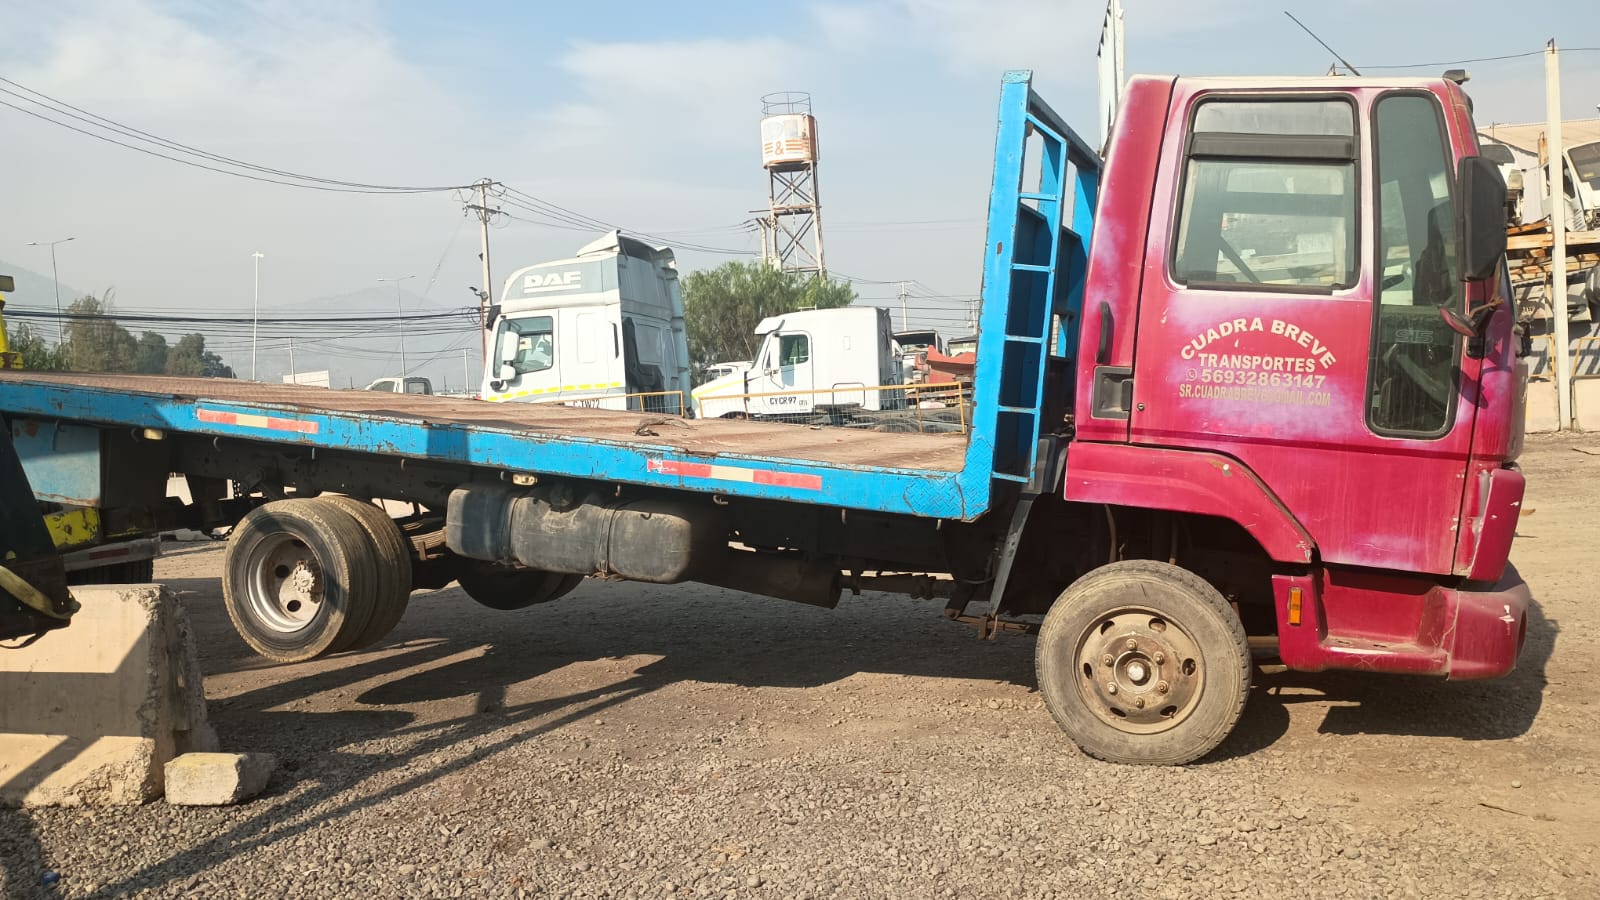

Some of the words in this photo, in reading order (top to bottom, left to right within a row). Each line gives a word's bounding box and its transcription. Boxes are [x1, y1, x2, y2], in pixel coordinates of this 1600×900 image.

[524, 271, 582, 289] DAF
[1180, 317, 1264, 360] CUADRA
[1270, 319, 1337, 369] BREVE
[1198, 353, 1316, 373] TRANSPORTES
[1200, 369, 1326, 389] 56932863147
